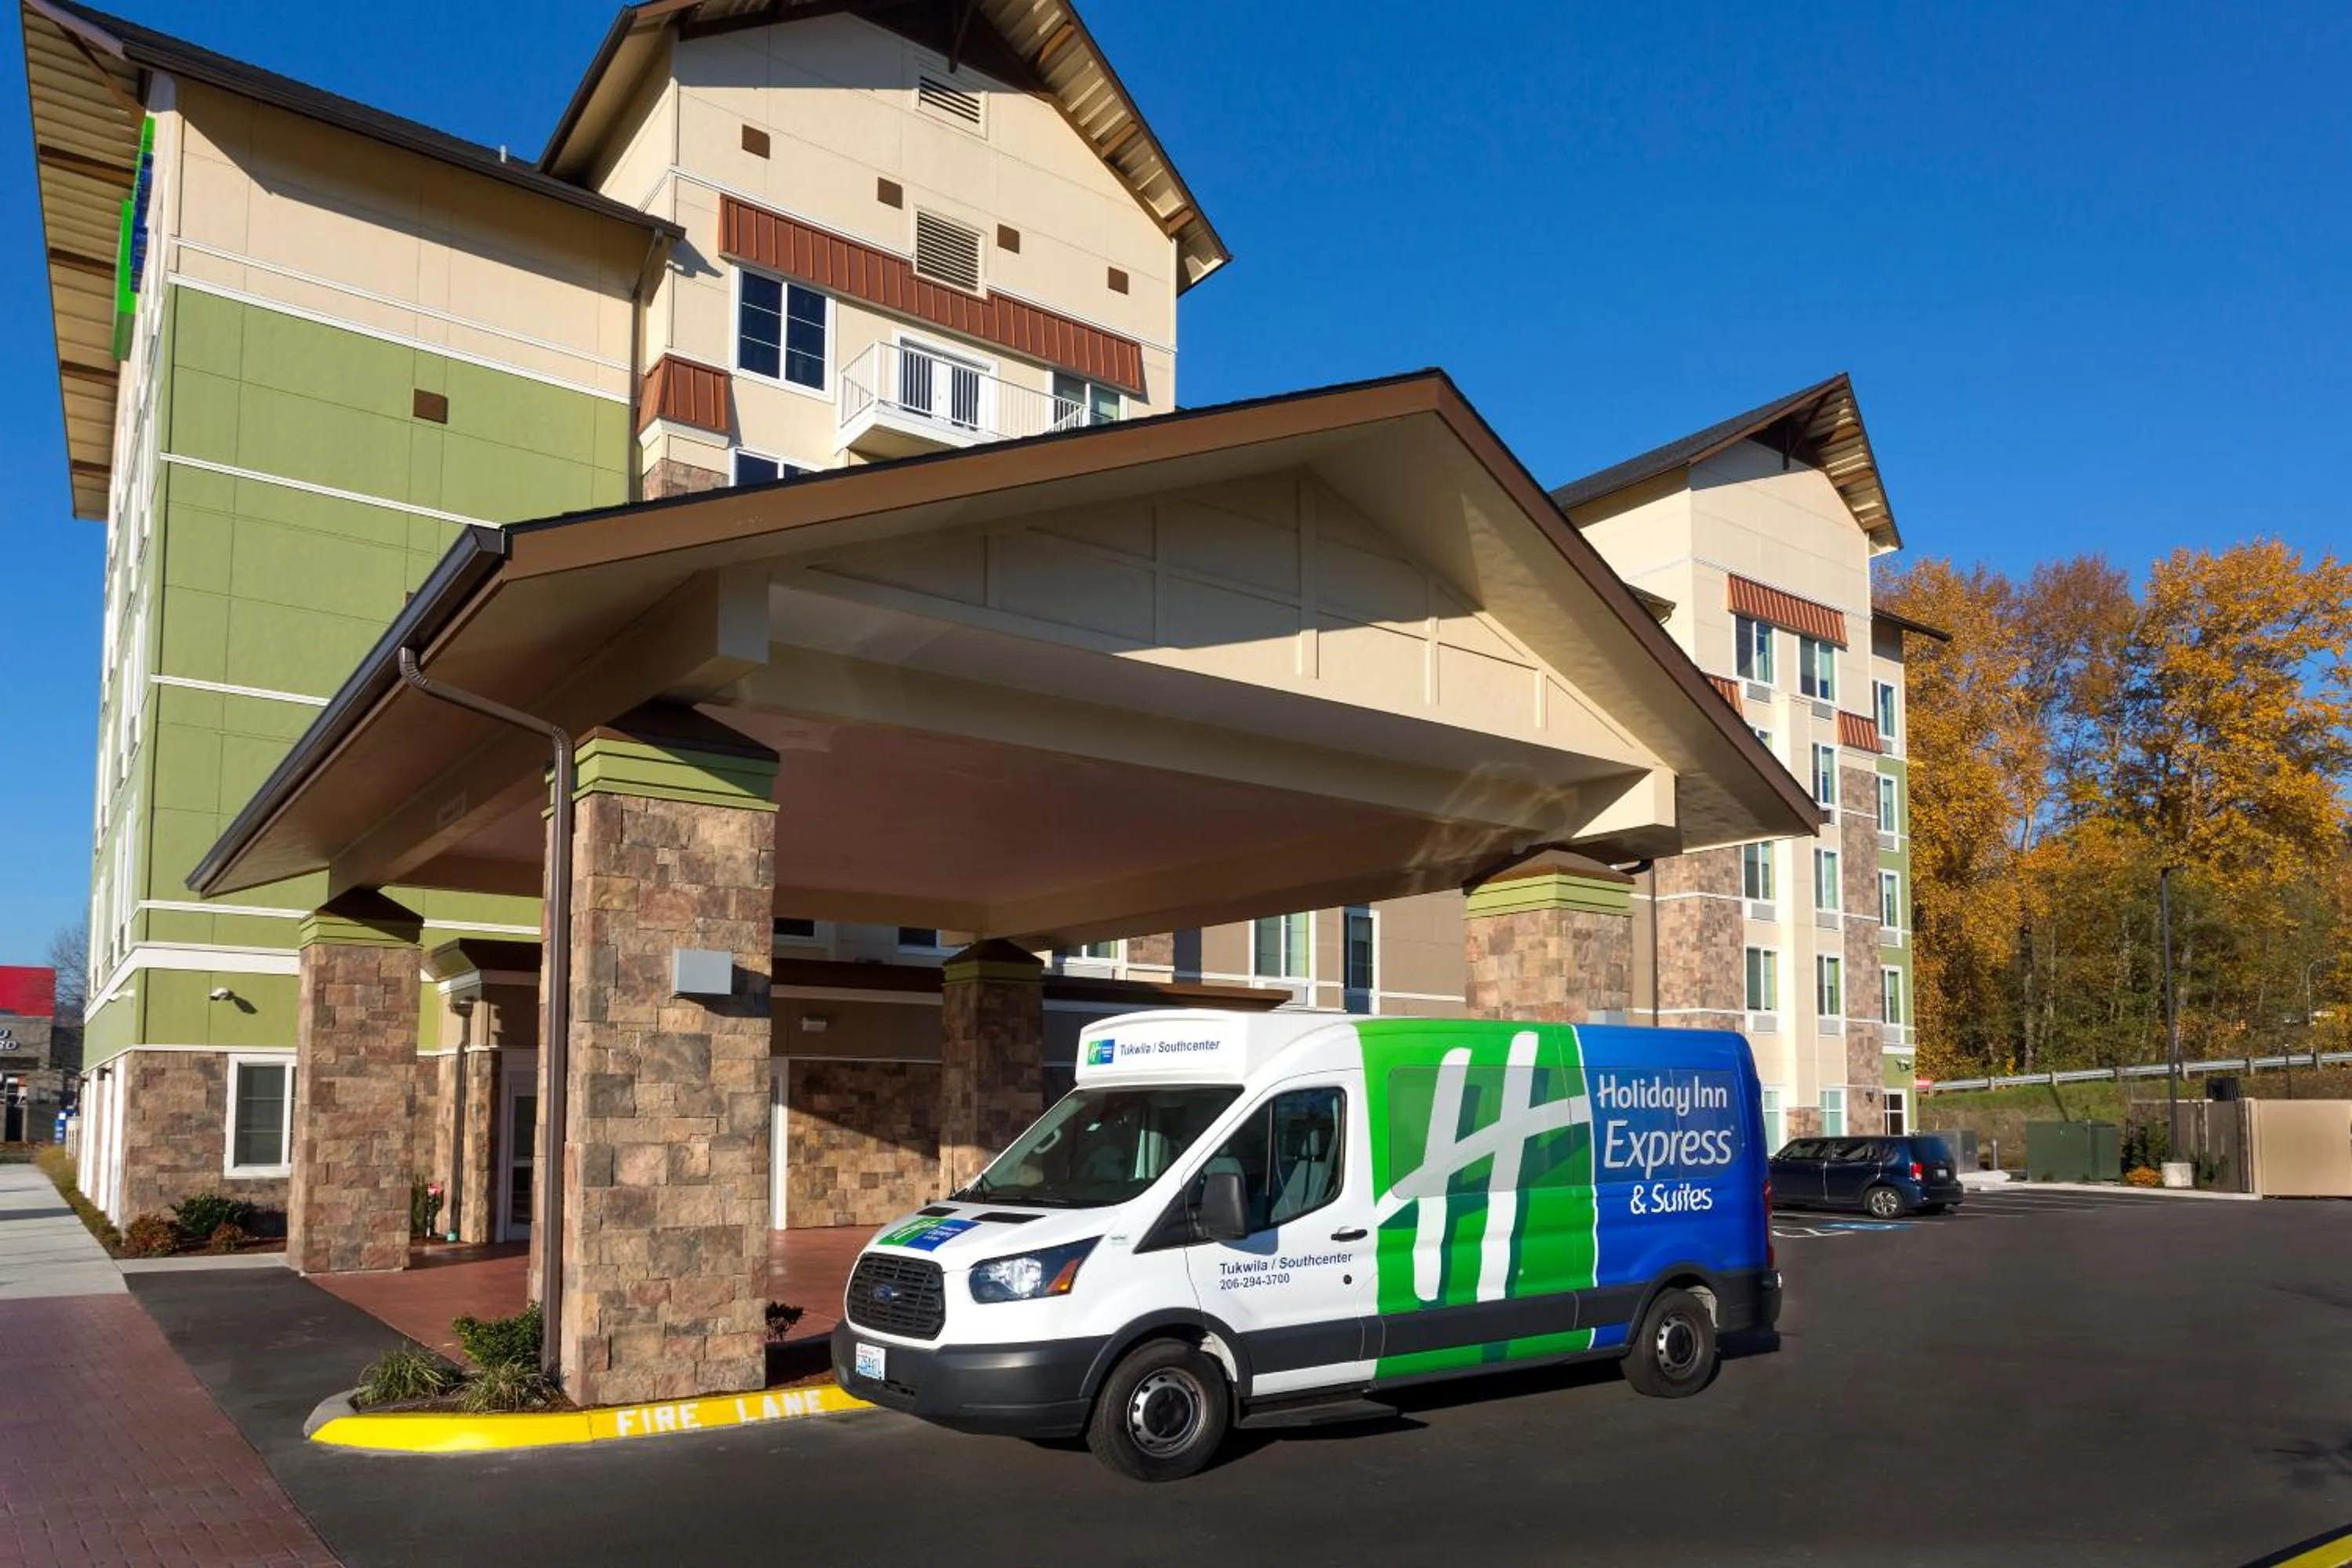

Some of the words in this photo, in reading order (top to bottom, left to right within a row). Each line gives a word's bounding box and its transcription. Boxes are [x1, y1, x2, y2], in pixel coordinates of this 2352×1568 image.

[1120, 1044, 1151, 1056] Tukwila
[1158, 1040, 1221, 1054] Southcenter
[1604, 1120, 1733, 1180] Express
[1630, 1185, 1647, 1215] &
[1651, 1183, 1713, 1214] Suites
[1220, 1260, 1268, 1276] Tukwila
[1279, 1253, 1353, 1270] Southcenter
[1219, 1272, 1290, 1290] 206-294-3700
[615, 1403, 702, 1437] FIRE
[735, 1388, 826, 1423] LANE
